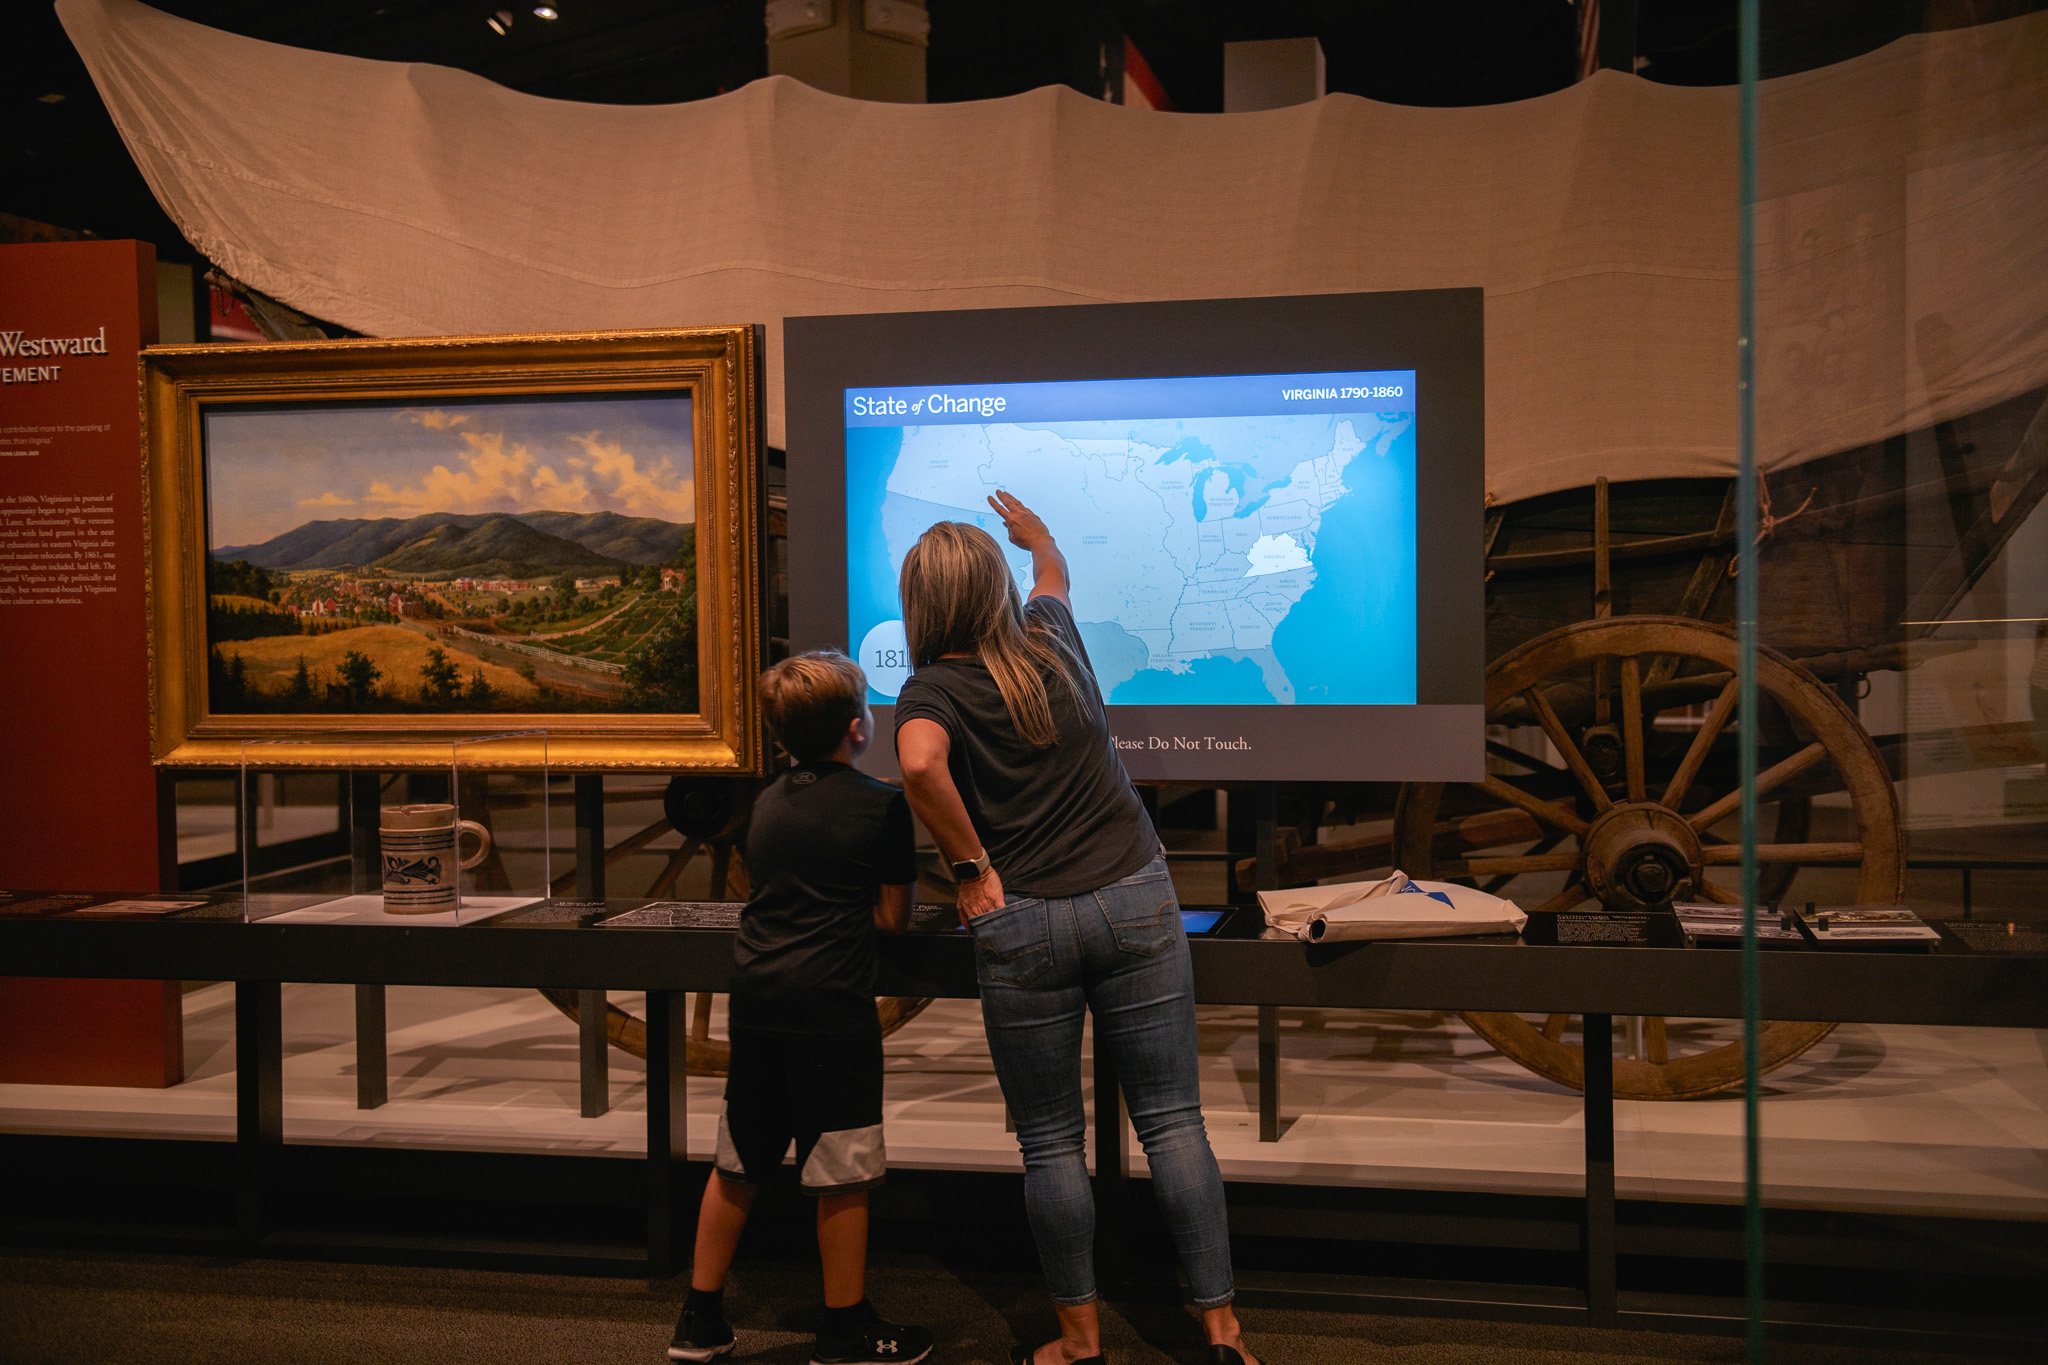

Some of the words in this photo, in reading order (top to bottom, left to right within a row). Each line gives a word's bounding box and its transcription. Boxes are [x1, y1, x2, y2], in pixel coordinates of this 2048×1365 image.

[0, 326, 107, 357] Westward
[0, 366, 61, 383] EMENT
[1281, 388, 1338, 400] VIRGINIA
[1340, 386, 1403, 399] 1790-1860
[853, 396, 907, 416] State
[911, 399, 925, 416] of
[927, 394, 1006, 417] Change
[40, 495, 72, 505] Virginians
[73, 494, 81, 502] in
[82, 494, 104, 504] pursuit
[105, 493, 114, 501] of
[37, 506, 57, 516] began
[65, 506, 81, 515] push
[82, 505, 114, 513] settlement
[26, 517, 71, 527] Revolutionary
[72, 517, 86, 525] War
[21, 529, 37, 537] with
[38, 528, 53, 537] land
[77, 528, 85, 536] in
[87, 528, 98, 536] the
[73, 540, 99, 550] Virginia
[100, 539, 115, 547] after
[102, 561, 116, 570] The
[20, 574, 47, 584] Virginia
[84, 585, 117, 595] Virginians
[875, 649, 907, 668] 181
[1148, 736, 1169, 750] Do
[1173, 736, 1200, 750] Not
[1203, 736, 1252, 750] Touch.
